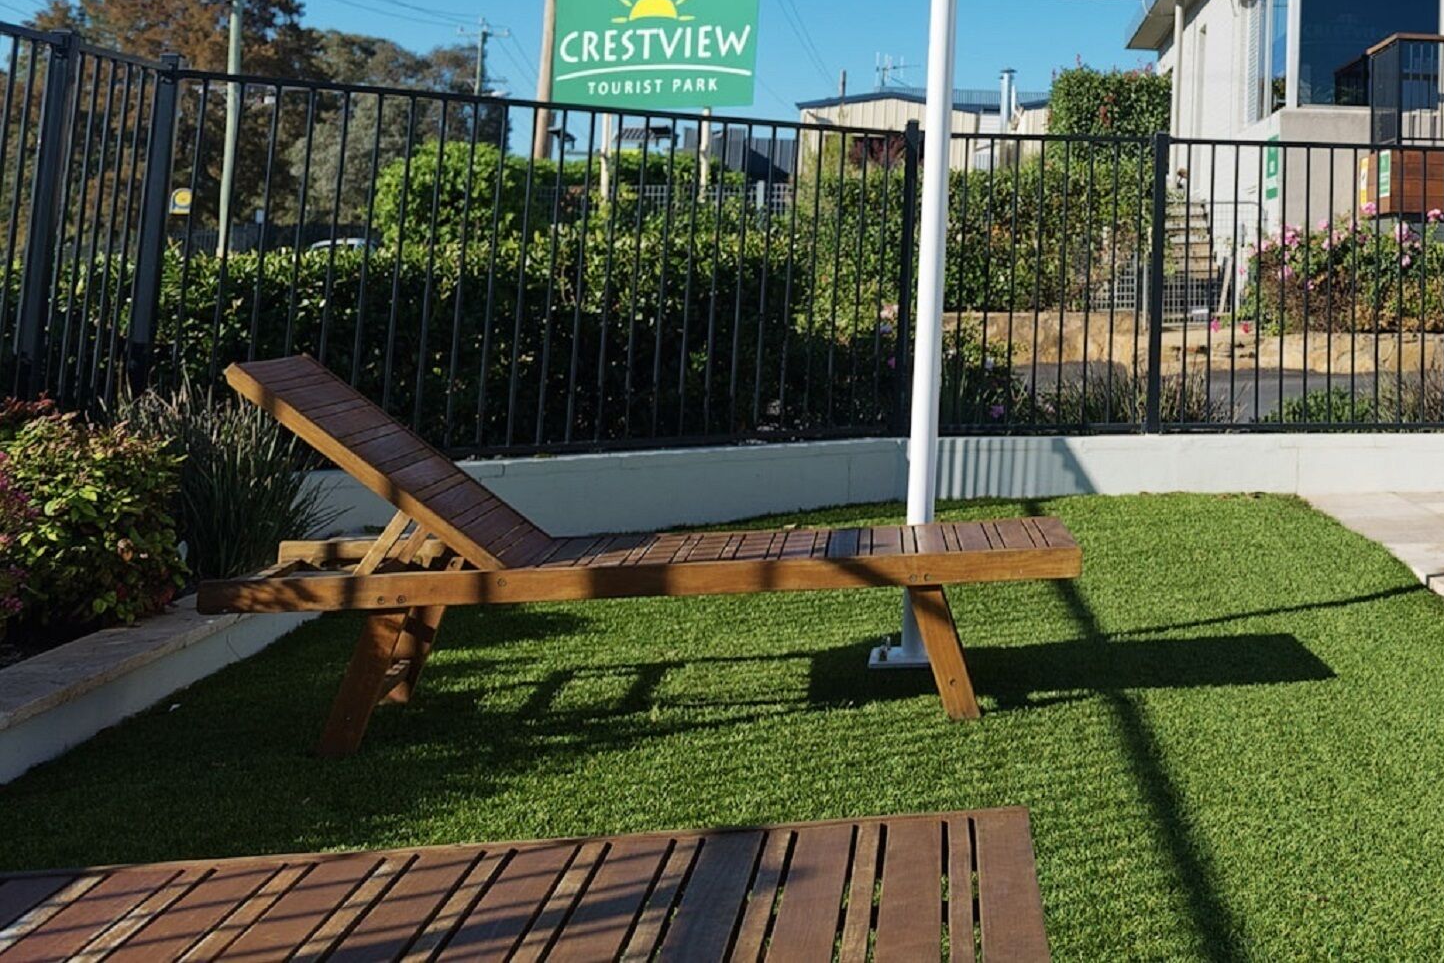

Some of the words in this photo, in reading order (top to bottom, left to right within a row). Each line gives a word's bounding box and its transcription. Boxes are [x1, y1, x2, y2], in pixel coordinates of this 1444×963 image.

[559, 24, 752, 64] CRESTVIEW
[587, 79, 664, 96] TOURIST
[671, 76, 719, 93] PARK
